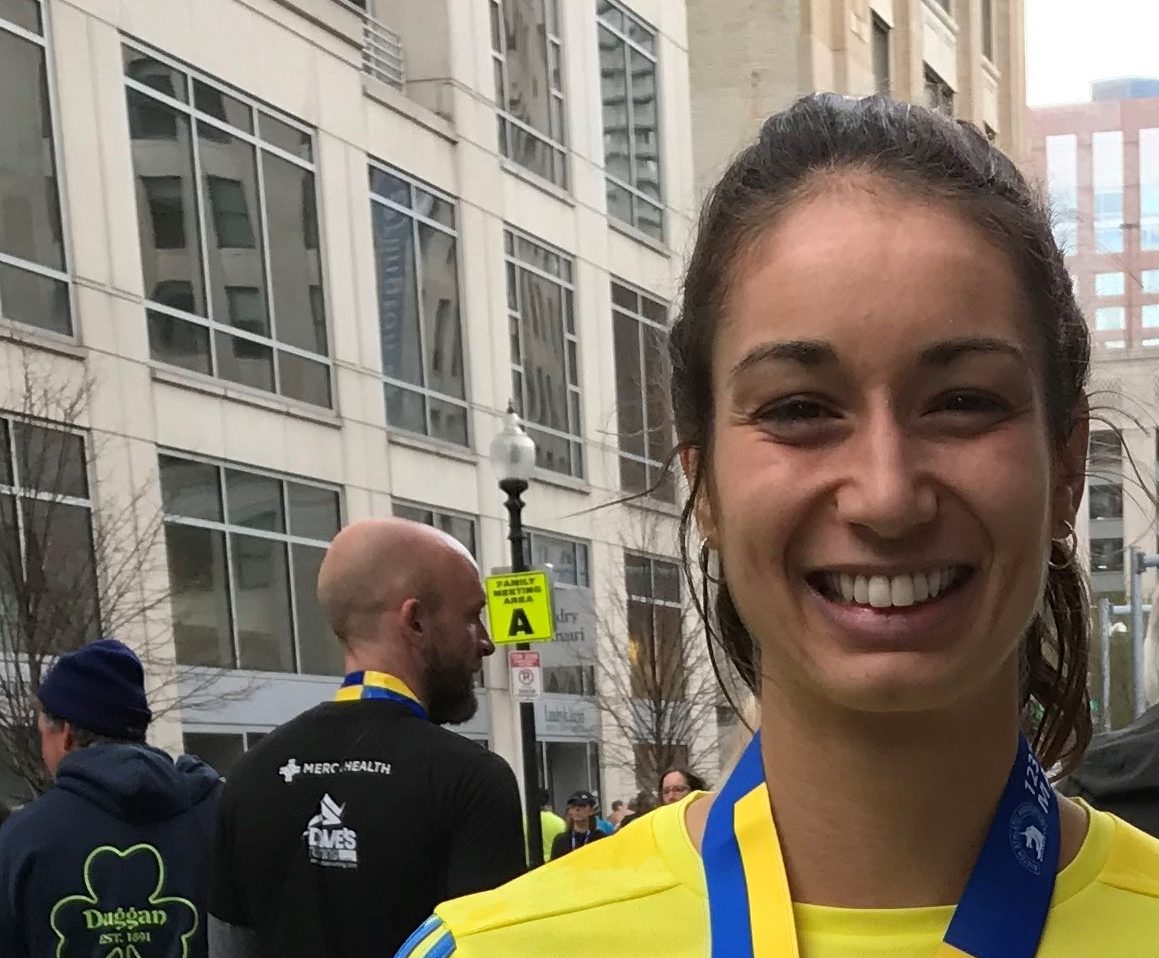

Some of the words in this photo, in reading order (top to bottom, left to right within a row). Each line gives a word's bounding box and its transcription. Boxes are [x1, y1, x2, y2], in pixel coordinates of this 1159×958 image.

[496, 578, 536, 587] FAMILY
[493, 586, 542, 596] MEETING
[503, 596, 534, 605] AREA
[508, 608, 534, 636] A
[344, 760, 392, 775] HEALTH
[1024, 753, 1041, 796] 123
[82, 906, 168, 931] Duggan
[99, 932, 124, 945] EST.
